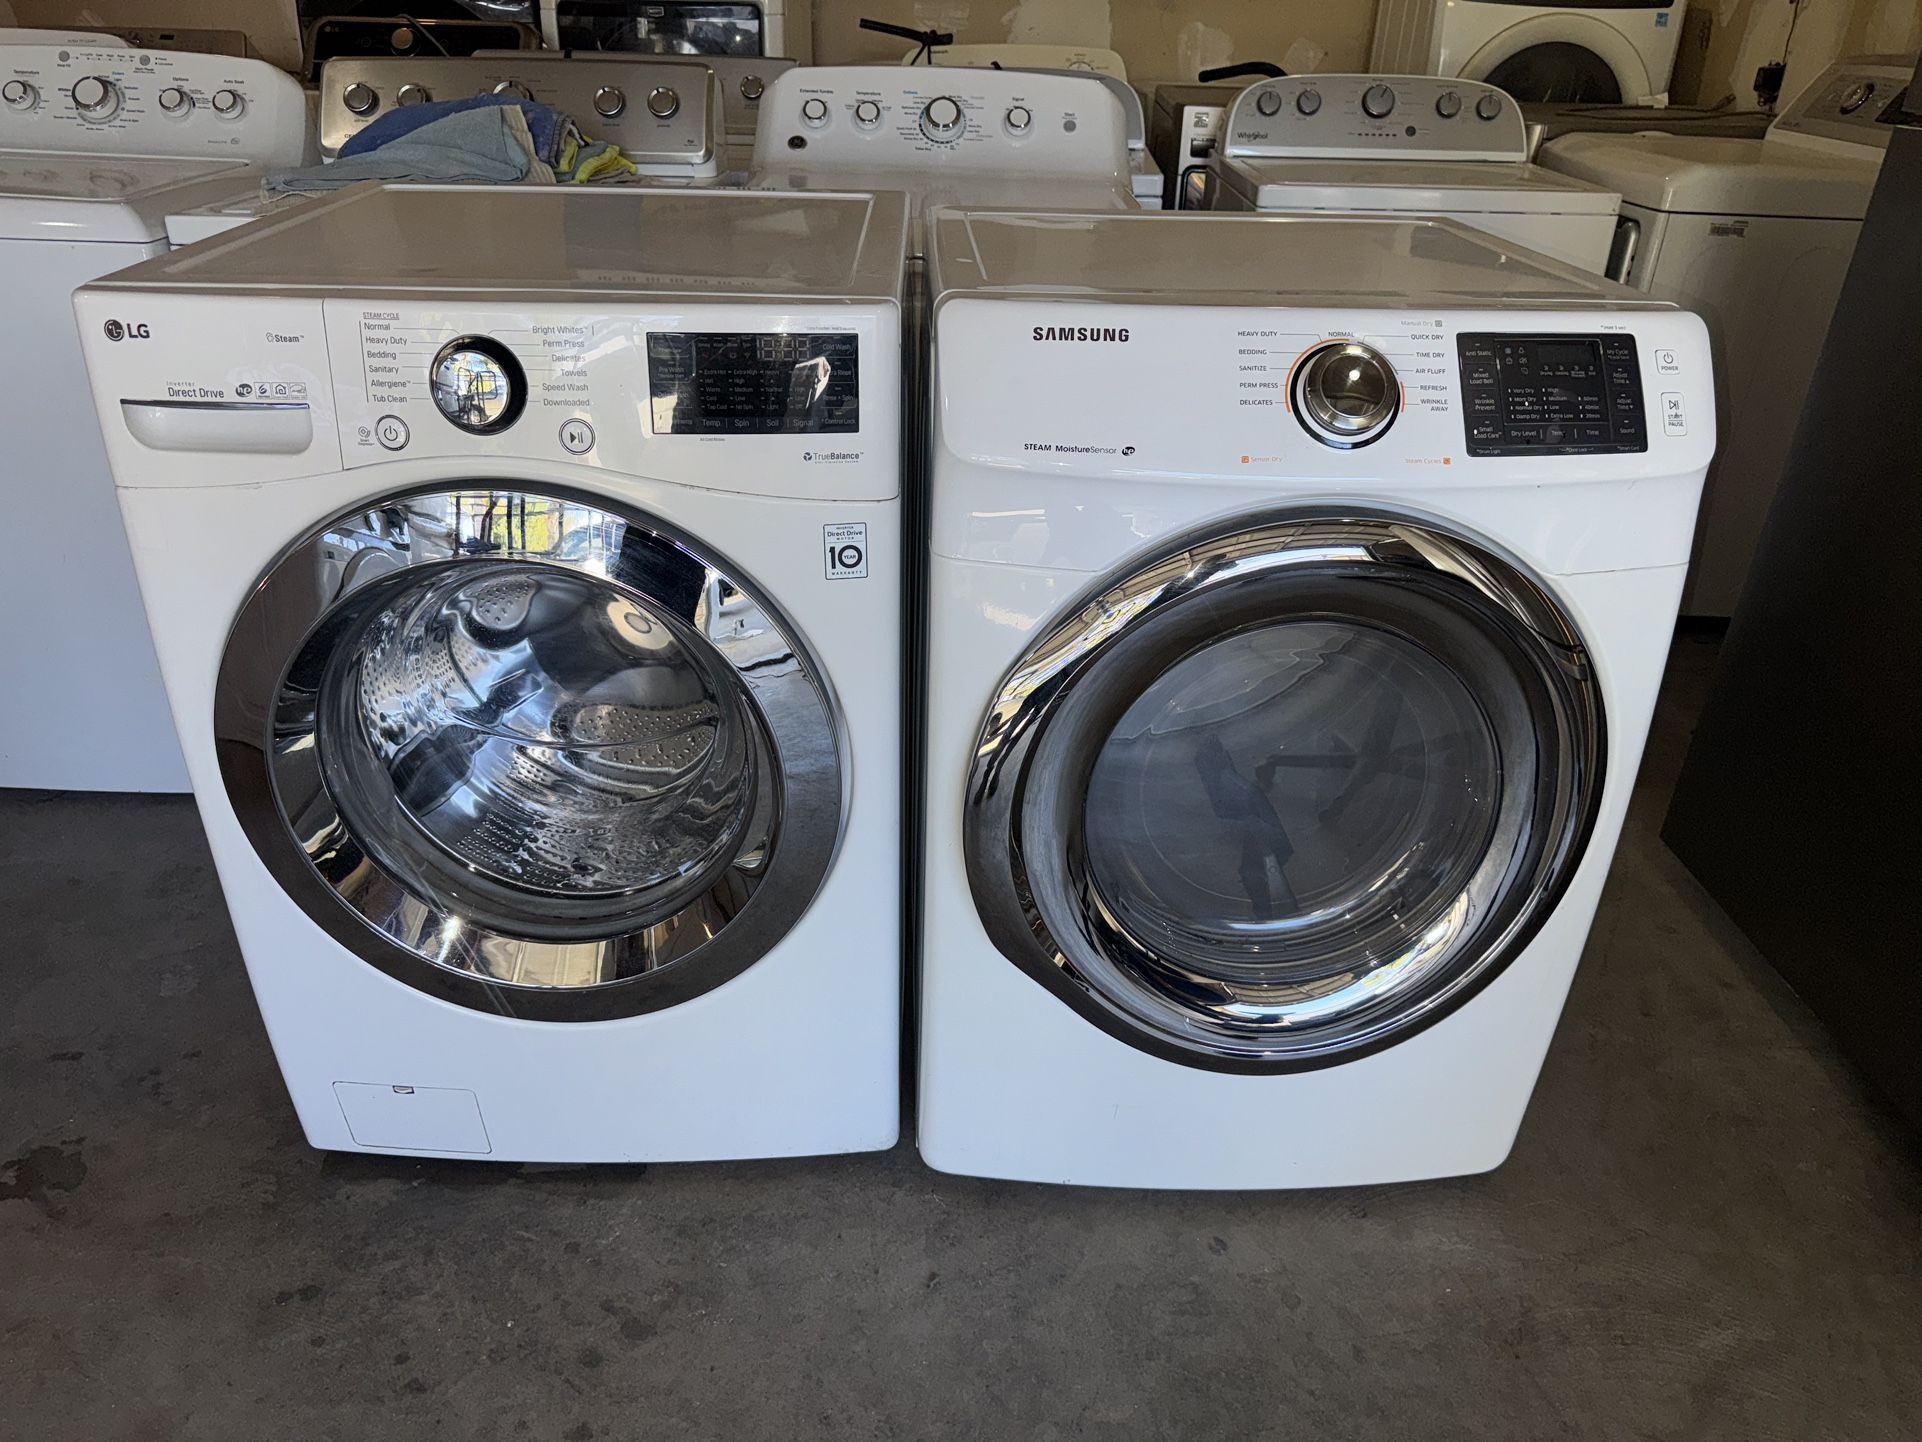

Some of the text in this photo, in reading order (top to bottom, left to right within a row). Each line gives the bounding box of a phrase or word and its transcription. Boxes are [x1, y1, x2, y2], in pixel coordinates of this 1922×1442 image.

[1237, 131, 1269, 142] Whirlpool
[362, 311, 400, 320] STEAM CYCLE
[363, 322, 391, 331] Normal
[1422, 320, 1434, 328] Dry
[126, 323, 151, 339] LG
[532, 325, 556, 336] Bright
[1032, 326, 1130, 343] SAMSUNG
[365, 335, 408, 346] Heavy Duty
[366, 350, 397, 361] Bedding
[551, 354, 586, 363] Delicates
[368, 364, 399, 375] Sanitary
[560, 368, 588, 377] Towels
[542, 382, 589, 392] Speed Wash
[168, 387, 225, 398] Direct Drive
[372, 394, 408, 403] Tub Clean
[543, 398, 590, 407] Downloaded
[702, 419, 721, 428] Temp
[734, 418, 750, 428] Spin
[766, 418, 779, 427] Soil
[792, 418, 814, 428] Signal
[1511, 430, 1522, 438] Dry
[1024, 443, 1052, 452] STEAM
[828, 544, 863, 569] 10
